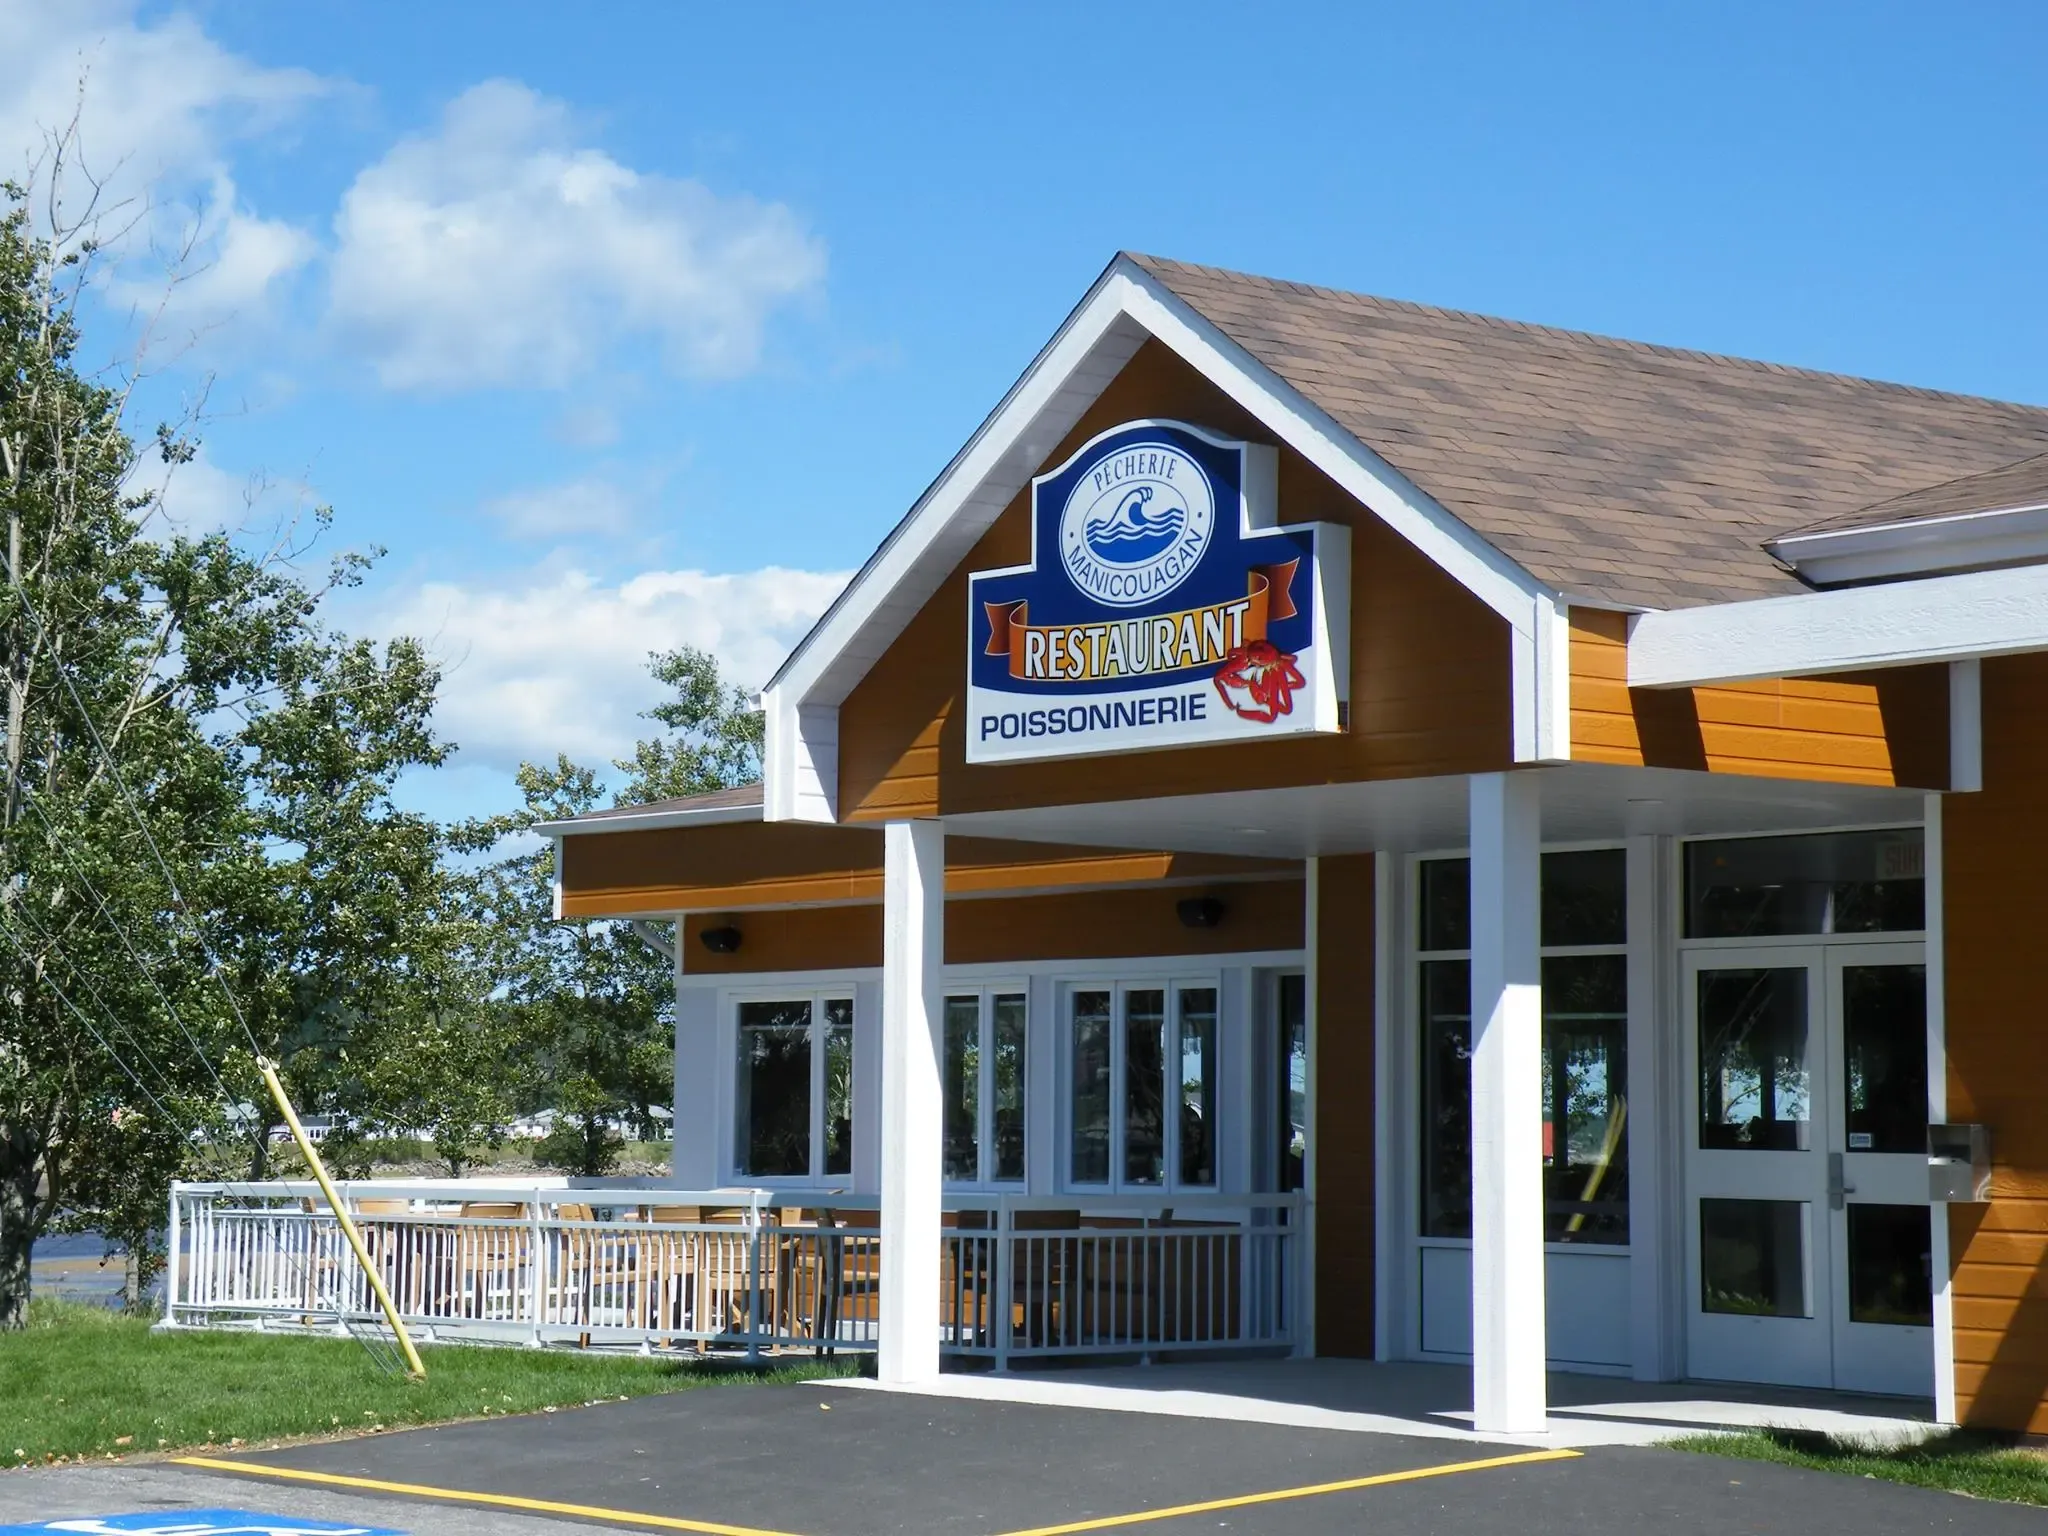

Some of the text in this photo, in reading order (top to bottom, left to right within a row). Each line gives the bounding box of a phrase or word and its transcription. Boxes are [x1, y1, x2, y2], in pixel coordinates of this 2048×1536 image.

[1094, 453, 1178, 491] PÊCHERIE
[1068, 528, 1203, 597] MANICOUAGAN
[1024, 601, 1250, 680] RESTAURANT
[981, 693, 1206, 741] POISSONNERIE
